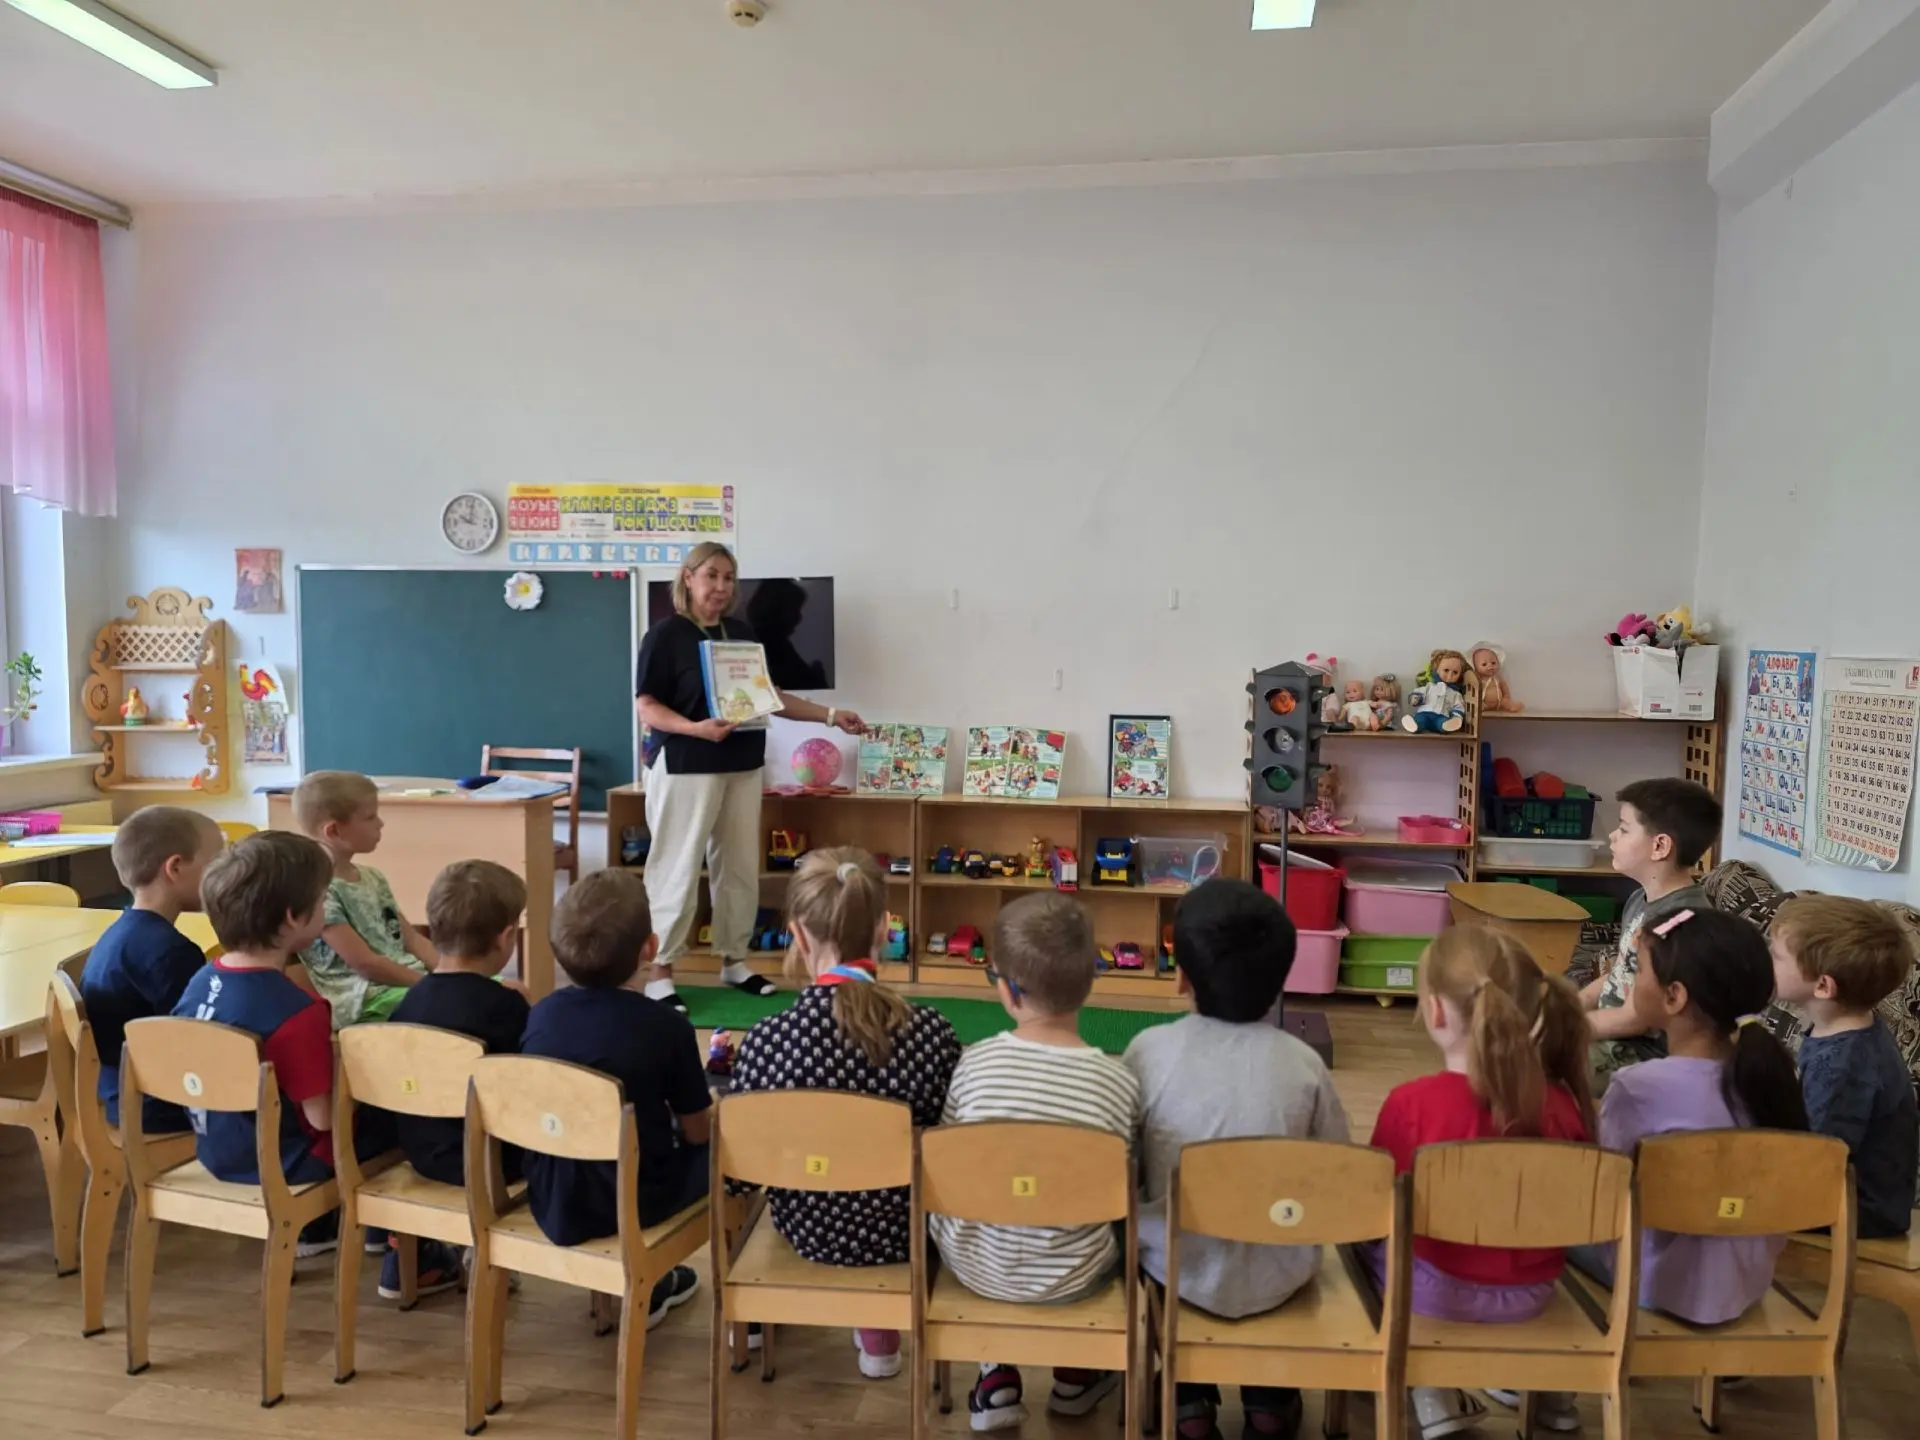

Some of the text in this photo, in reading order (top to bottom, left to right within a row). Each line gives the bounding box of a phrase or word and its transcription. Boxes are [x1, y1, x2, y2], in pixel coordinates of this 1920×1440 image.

[1766, 656, 1798, 671] АЛФАВИТ
[1772, 675, 1779, 688] Бб
[1798, 702, 1809, 717] Жж
[404, 1080, 412, 1091] 3
[813, 1160, 821, 1172] 3
[1020, 1180, 1028, 1192] 3
[1283, 1206, 1293, 1219] 3
[1727, 1202, 1736, 1215] 3
